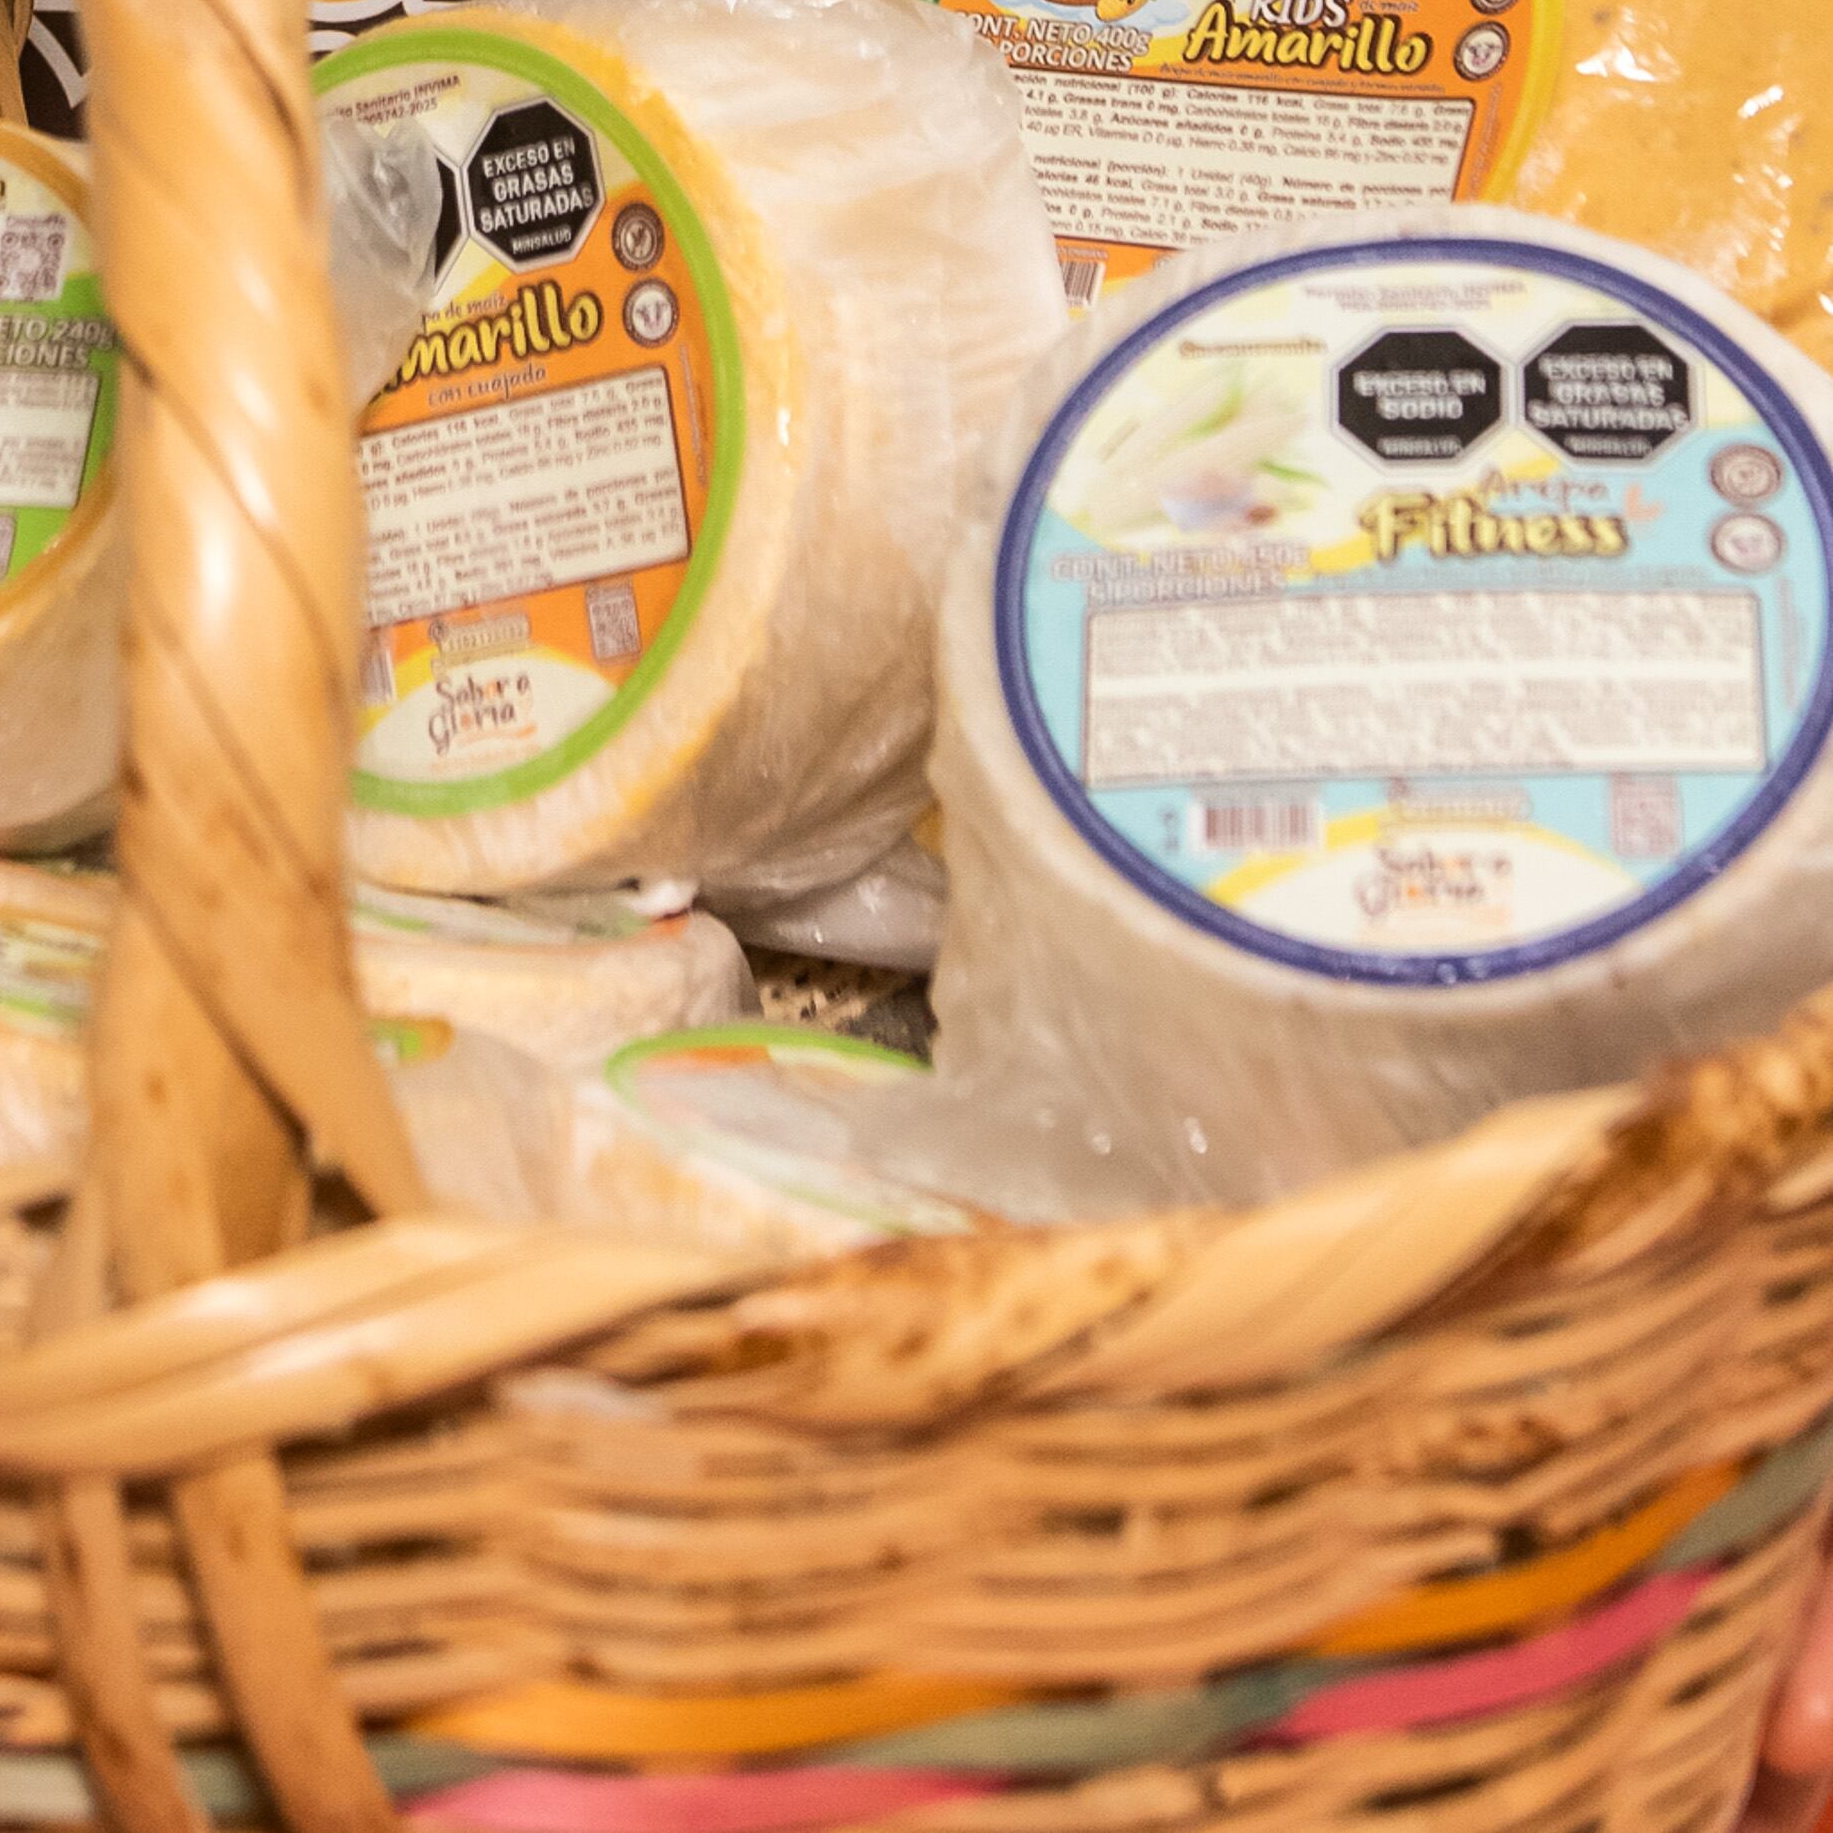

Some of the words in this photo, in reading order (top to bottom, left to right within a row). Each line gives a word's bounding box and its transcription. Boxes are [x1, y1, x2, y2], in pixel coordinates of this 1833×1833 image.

[969, 12, 1020, 39] ONT.
[1026, 16, 1094, 46] NETO
[1095, 24, 1154, 57] 400g
[999, 39, 1134, 74] PORCIONES
[482, 144, 550, 179] EXCESO
[553, 136, 576, 159] EN
[493, 161, 575, 203] GRASAS
[478, 184, 595, 234] SATURADAS
[382, 279, 605, 393] marillo
[1356, 487, 1632, 562] Fitness
